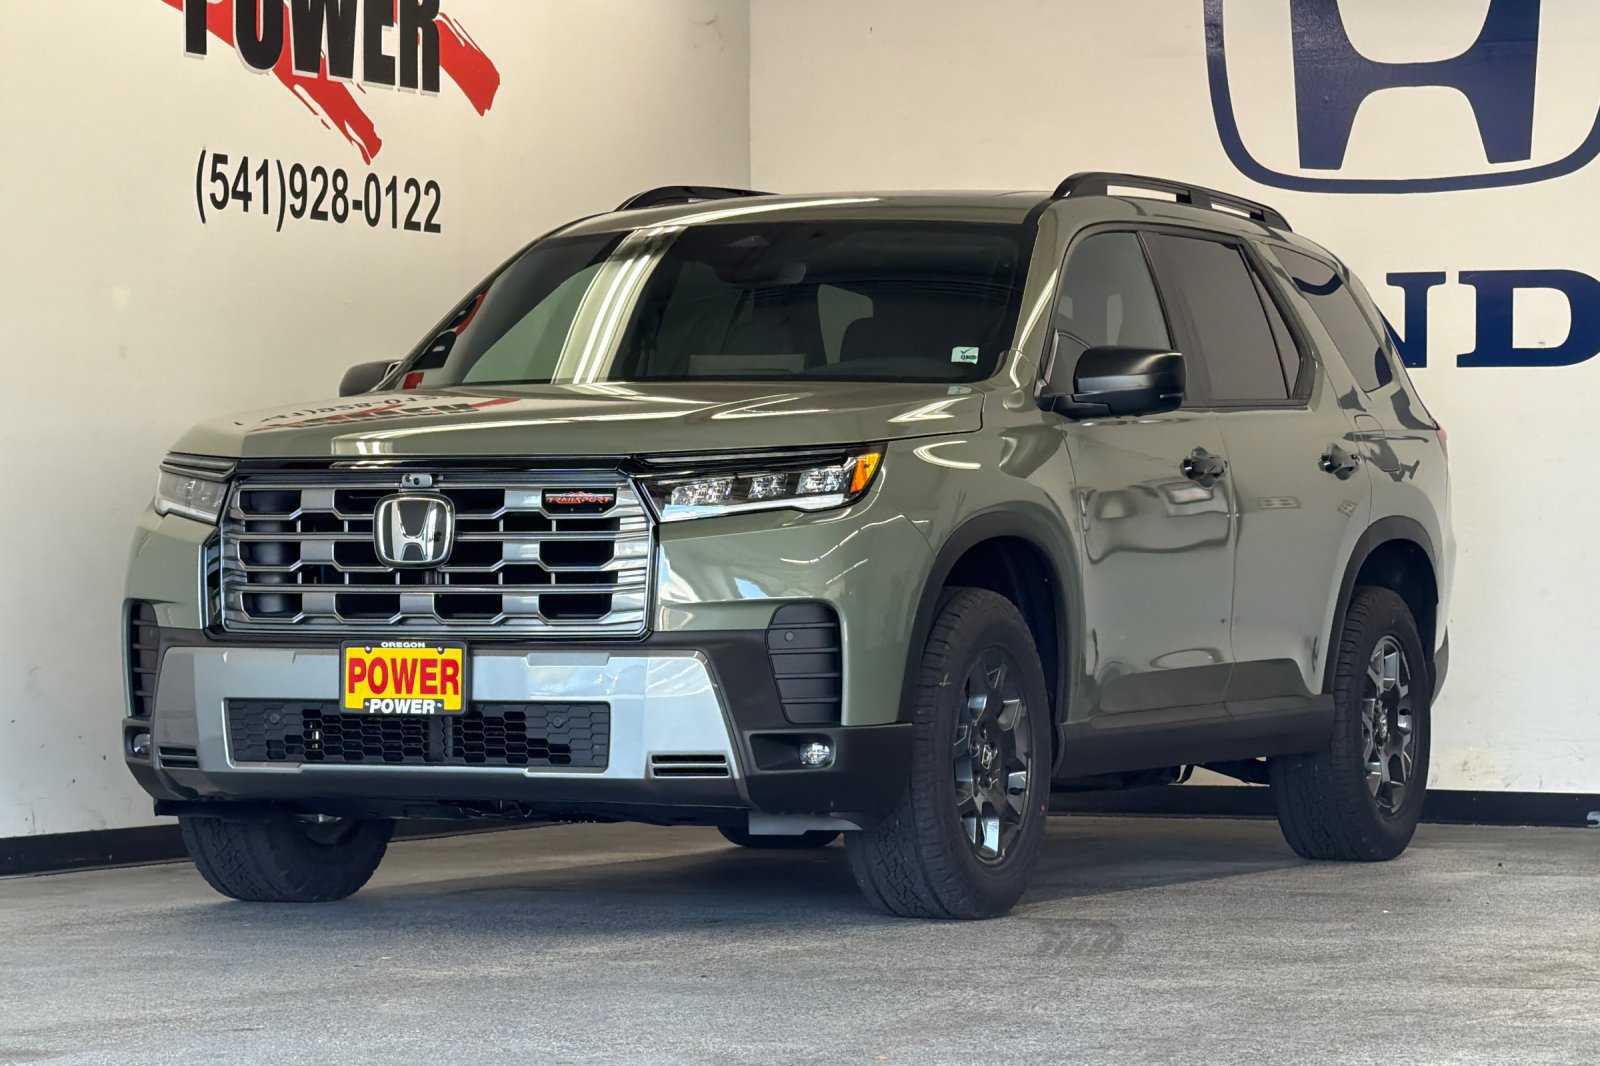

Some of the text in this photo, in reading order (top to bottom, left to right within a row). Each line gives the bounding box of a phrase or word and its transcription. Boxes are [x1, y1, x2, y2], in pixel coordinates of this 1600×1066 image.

[195, 148, 442, 233] (541)928-0122
[348, 657, 460, 695] POWER
[369, 698, 435, 714] POWER
